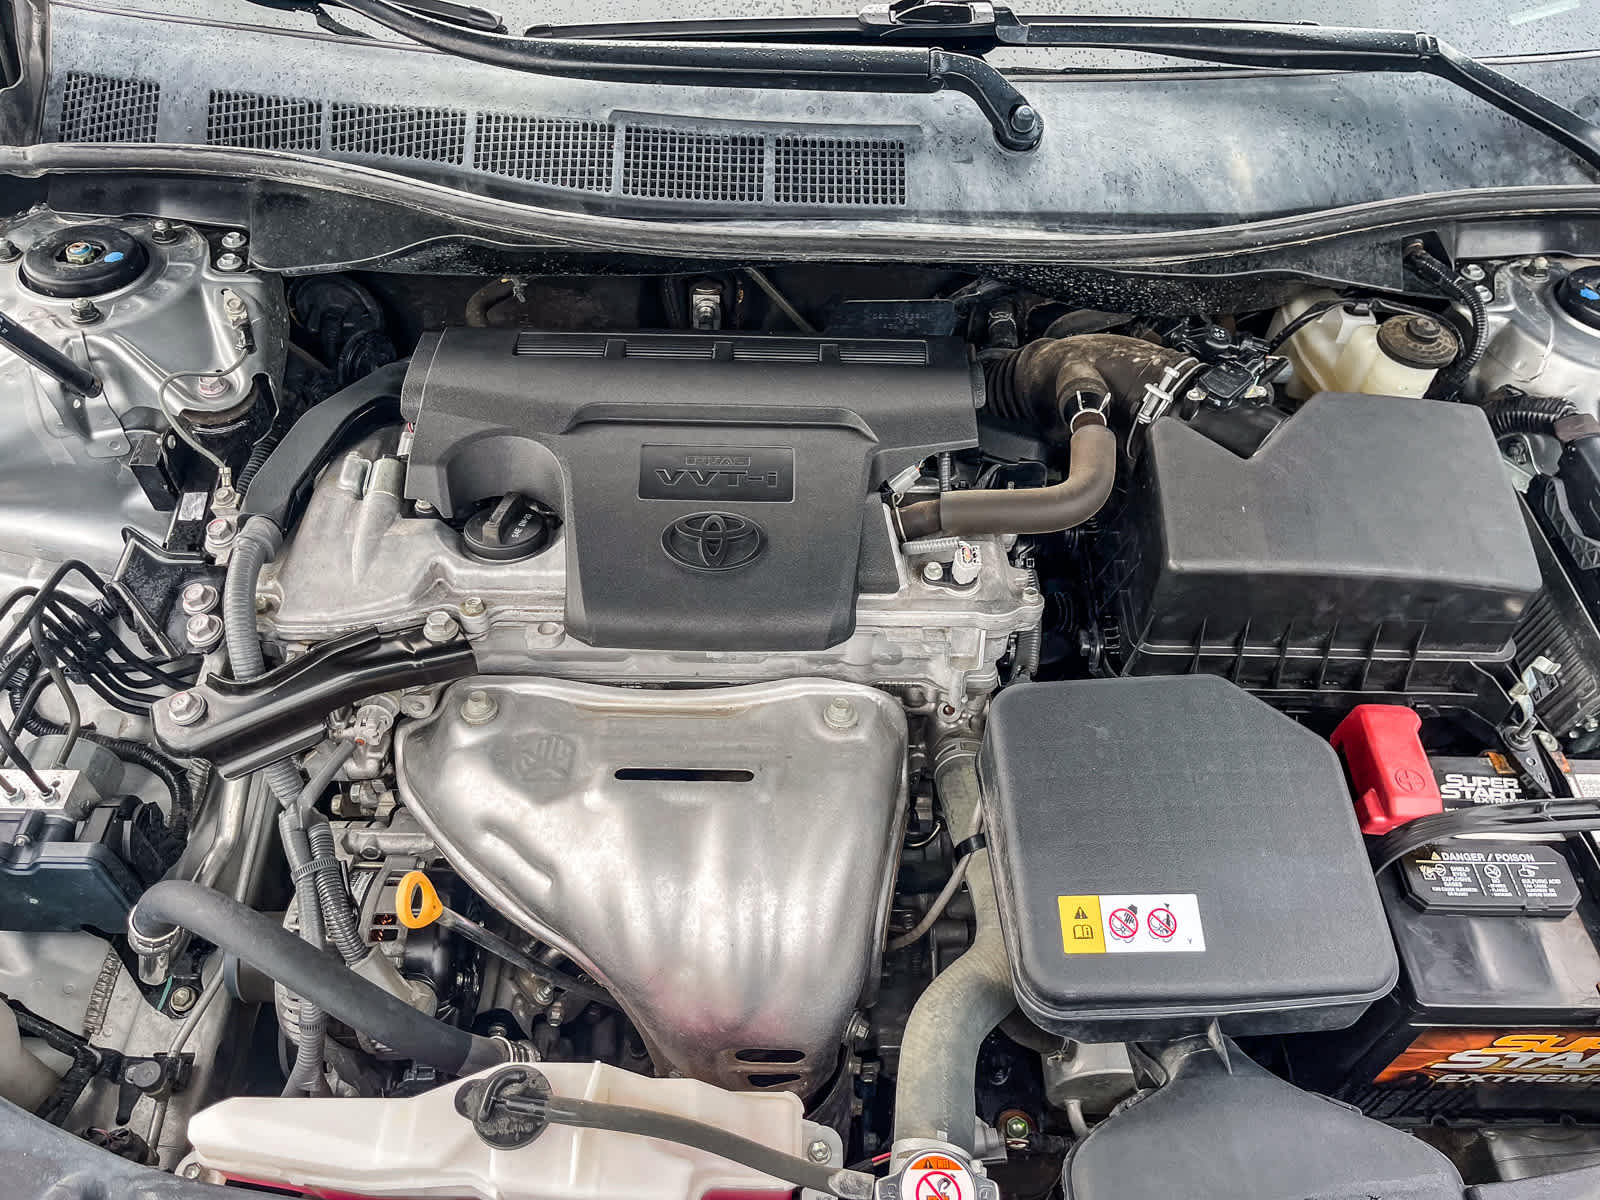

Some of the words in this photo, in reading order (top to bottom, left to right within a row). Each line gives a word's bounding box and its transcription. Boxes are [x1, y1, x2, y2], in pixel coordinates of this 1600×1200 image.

[654, 468, 777, 488] VVT-i
[1445, 773, 1519, 788] SUPER
[1440, 784, 1522, 799] START
[1441, 852, 1486, 862] DANGER
[1494, 853, 1536, 862] POISON
